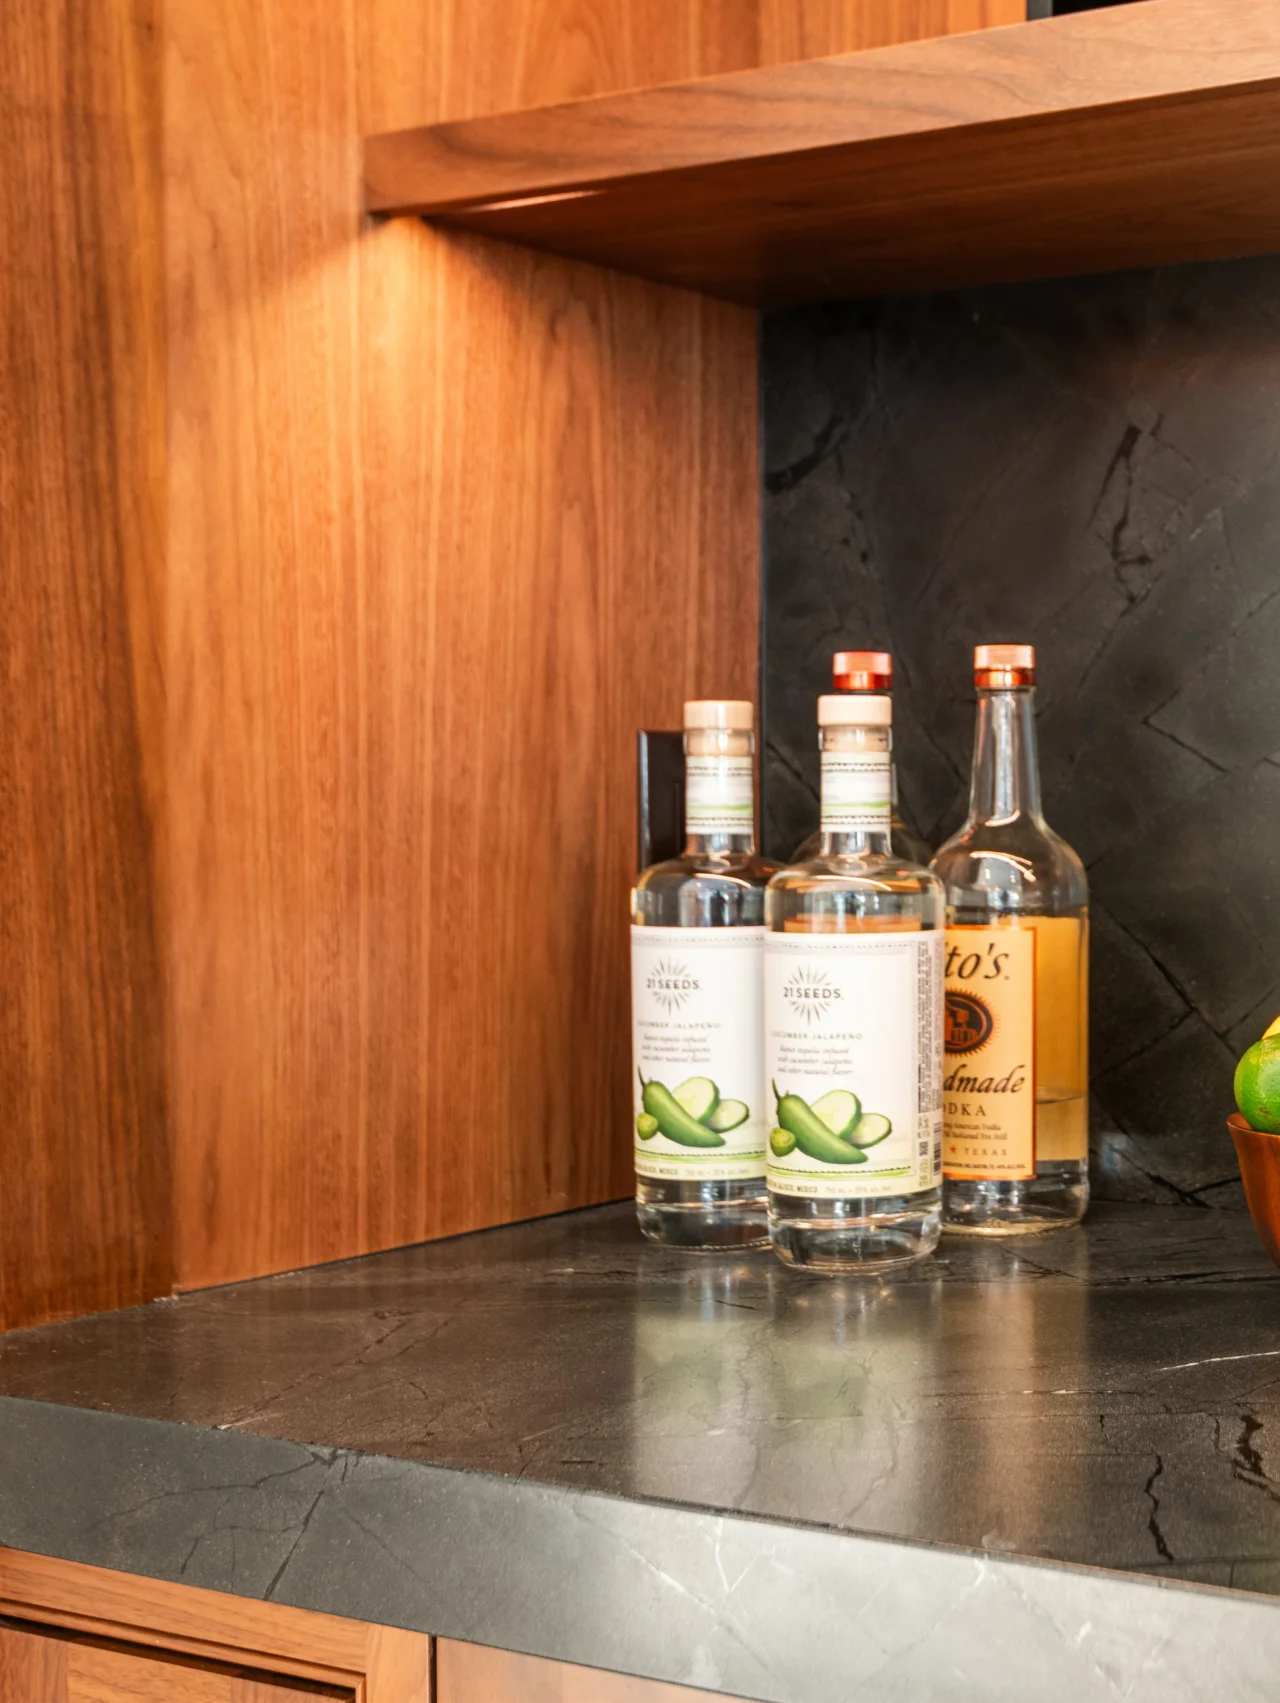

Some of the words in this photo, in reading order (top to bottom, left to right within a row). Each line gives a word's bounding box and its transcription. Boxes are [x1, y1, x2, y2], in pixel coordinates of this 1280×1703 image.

[944, 942, 1010, 980] to's
[943, 1063, 1026, 1094] dmade
[943, 1102, 987, 1117] DKA
[964, 1147, 1008, 1156] TEXAS
